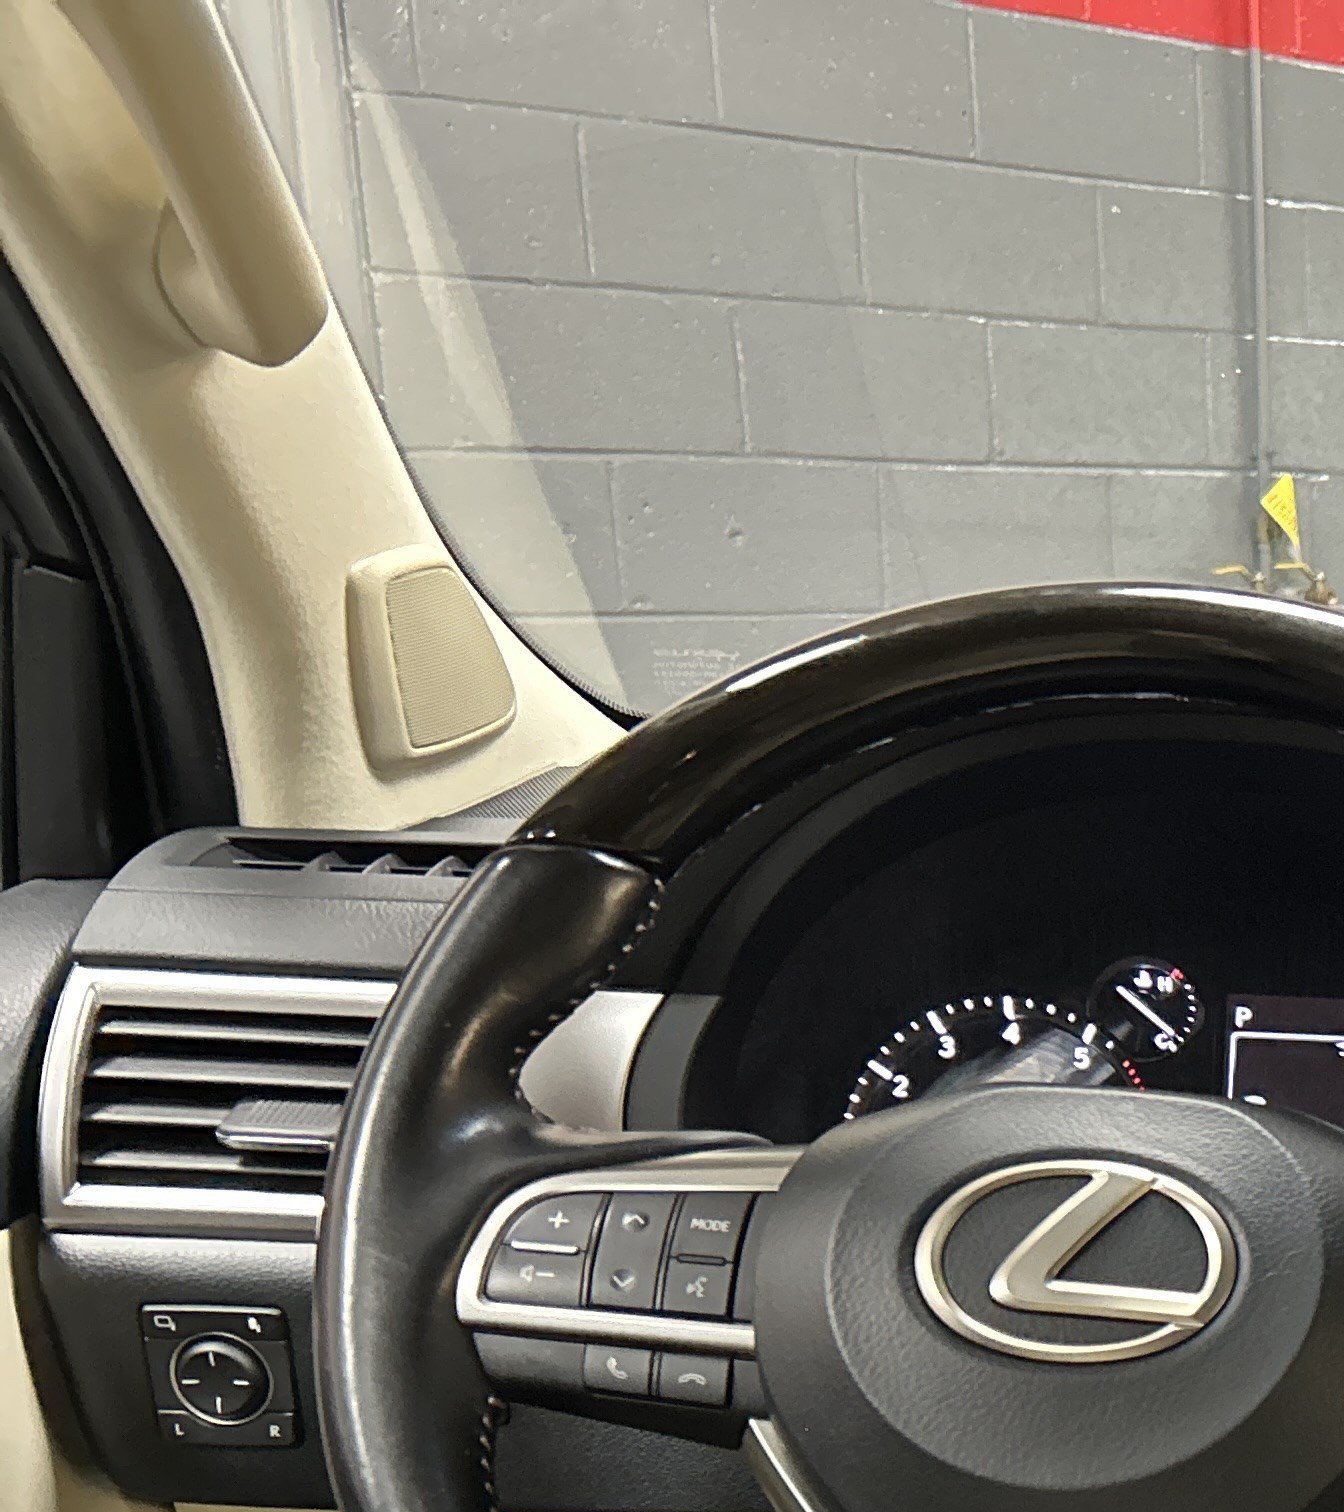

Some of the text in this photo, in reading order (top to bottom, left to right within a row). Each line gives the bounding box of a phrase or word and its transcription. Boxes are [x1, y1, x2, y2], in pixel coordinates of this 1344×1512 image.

[1157, 975, 1173, 994] H
[1235, 1006, 1253, 1028] P
[1002, 1022, 1021, 1046] 4
[938, 1035, 957, 1060] 3
[1073, 1046, 1091, 1070] 5
[892, 1074, 910, 1099] 2
[689, 1217, 731, 1233] MODE
[174, 1423, 185, 1436] L
[269, 1424, 281, 1437] R
